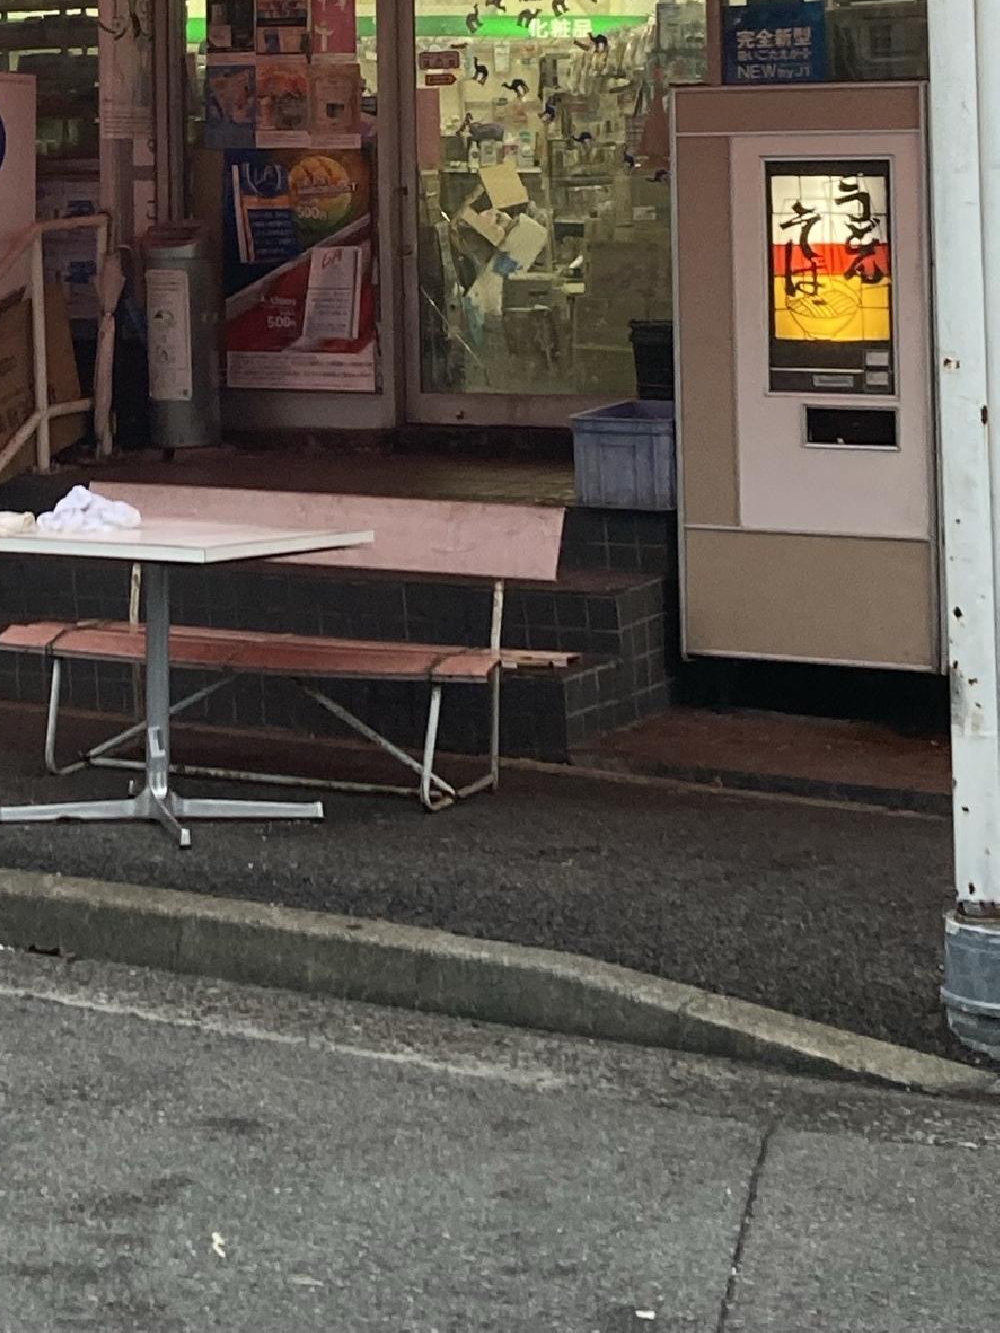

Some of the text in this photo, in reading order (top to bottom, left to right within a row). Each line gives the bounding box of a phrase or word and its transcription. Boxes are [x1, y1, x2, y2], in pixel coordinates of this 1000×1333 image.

[529, 18, 593, 38] 化粧品
[736, 27, 812, 49] 完全新型
[737, 63, 776, 79] NEW
[834, 175, 886, 285] うどん
